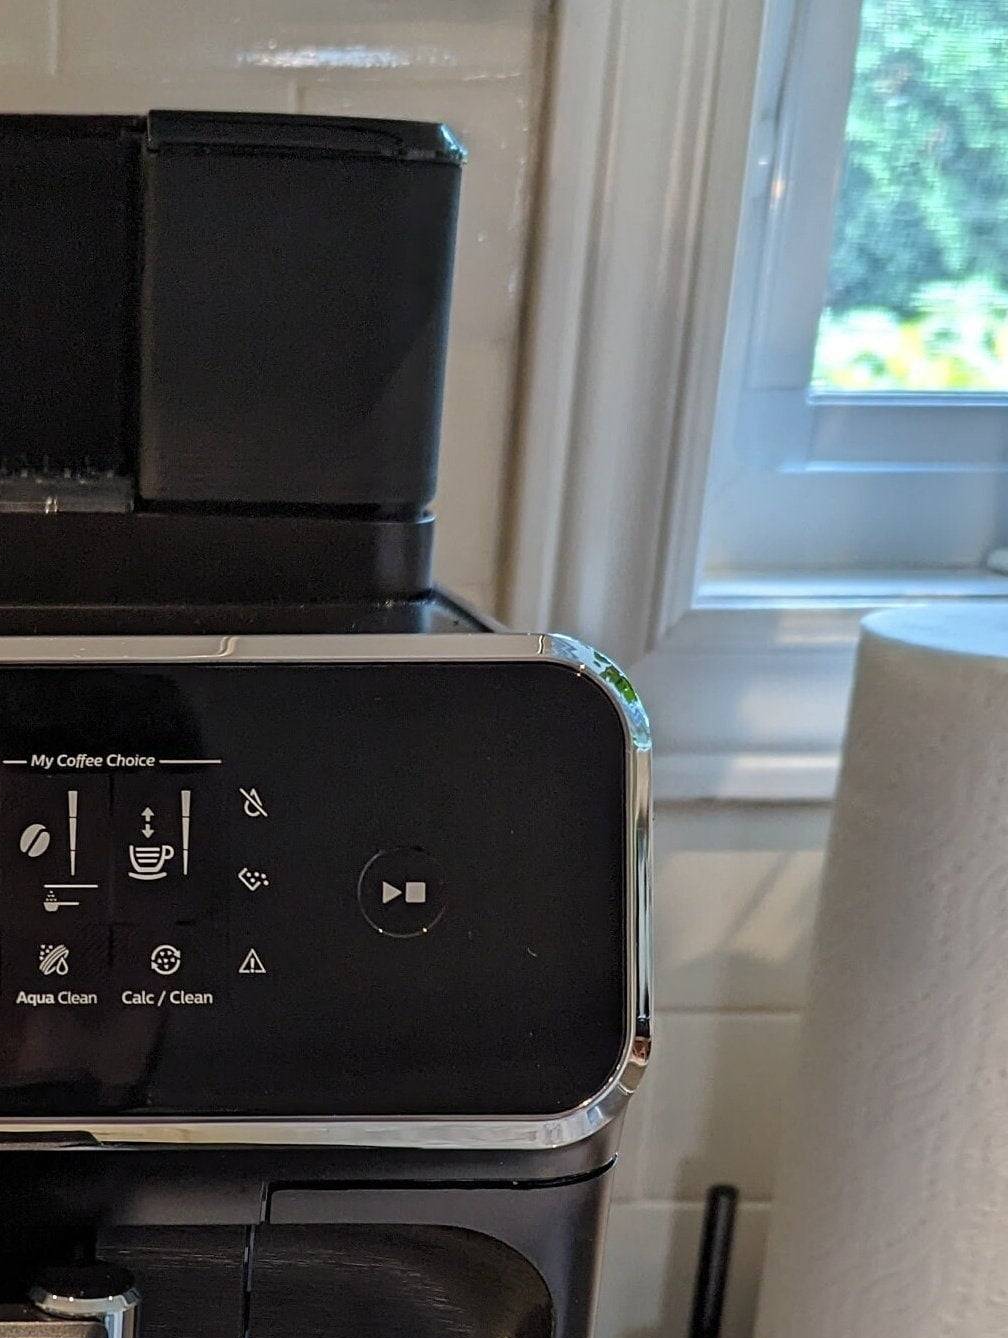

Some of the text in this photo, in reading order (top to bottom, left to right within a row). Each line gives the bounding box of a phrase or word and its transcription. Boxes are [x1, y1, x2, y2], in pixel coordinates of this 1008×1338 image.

[31, 753, 156, 770] My Coffee Choice
[16, 990, 98, 1007] Aqua Clean
[121, 990, 155, 1005] Calc
[169, 990, 214, 1005] Clean
